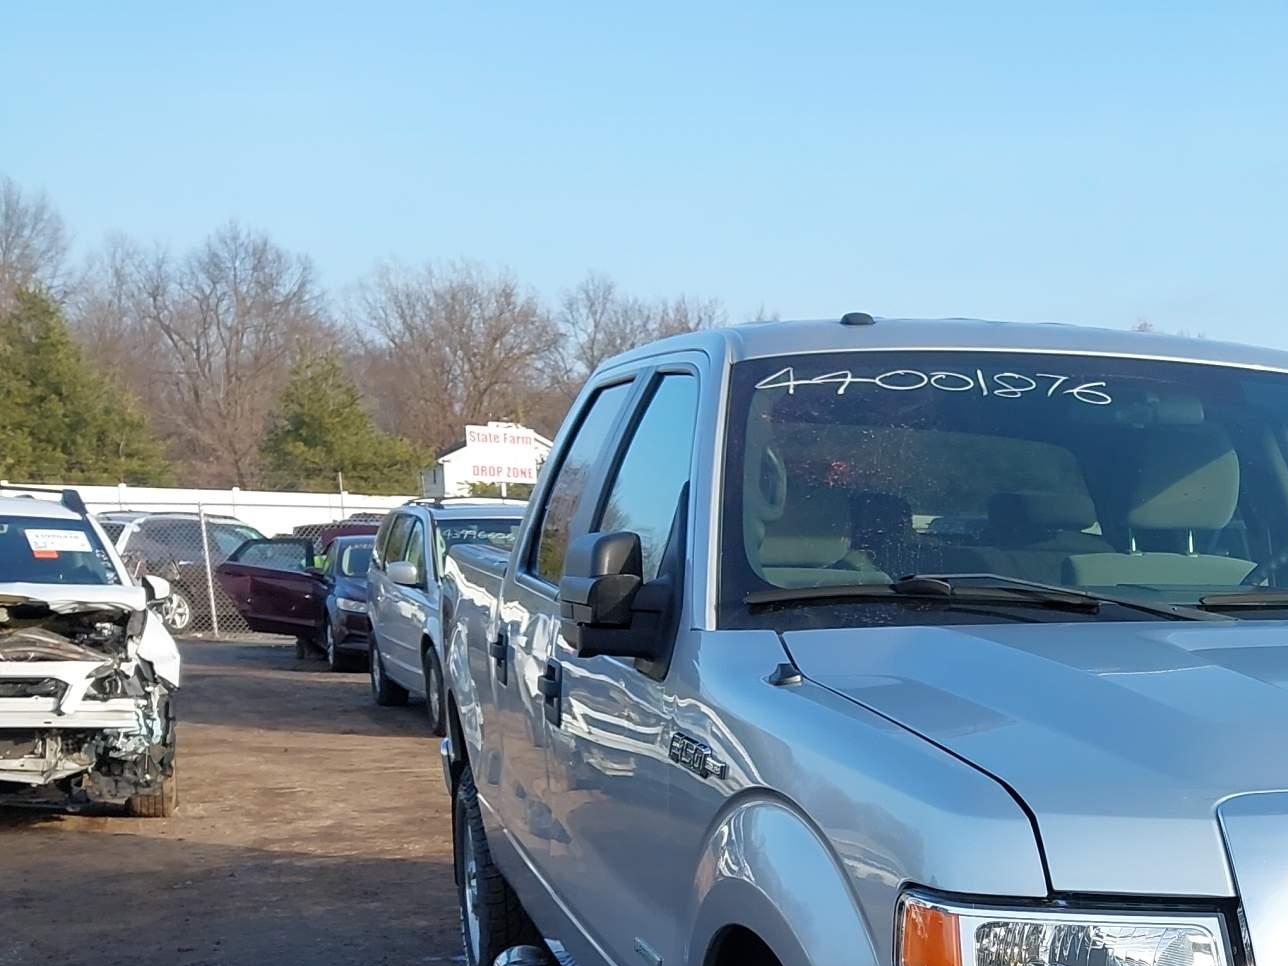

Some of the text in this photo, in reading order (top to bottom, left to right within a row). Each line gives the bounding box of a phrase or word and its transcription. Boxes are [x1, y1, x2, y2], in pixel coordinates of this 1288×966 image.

[754, 367, 1112, 405] 44001876
[469, 431, 532, 445] State Farm
[472, 465, 534, 479] DROP ZONE
